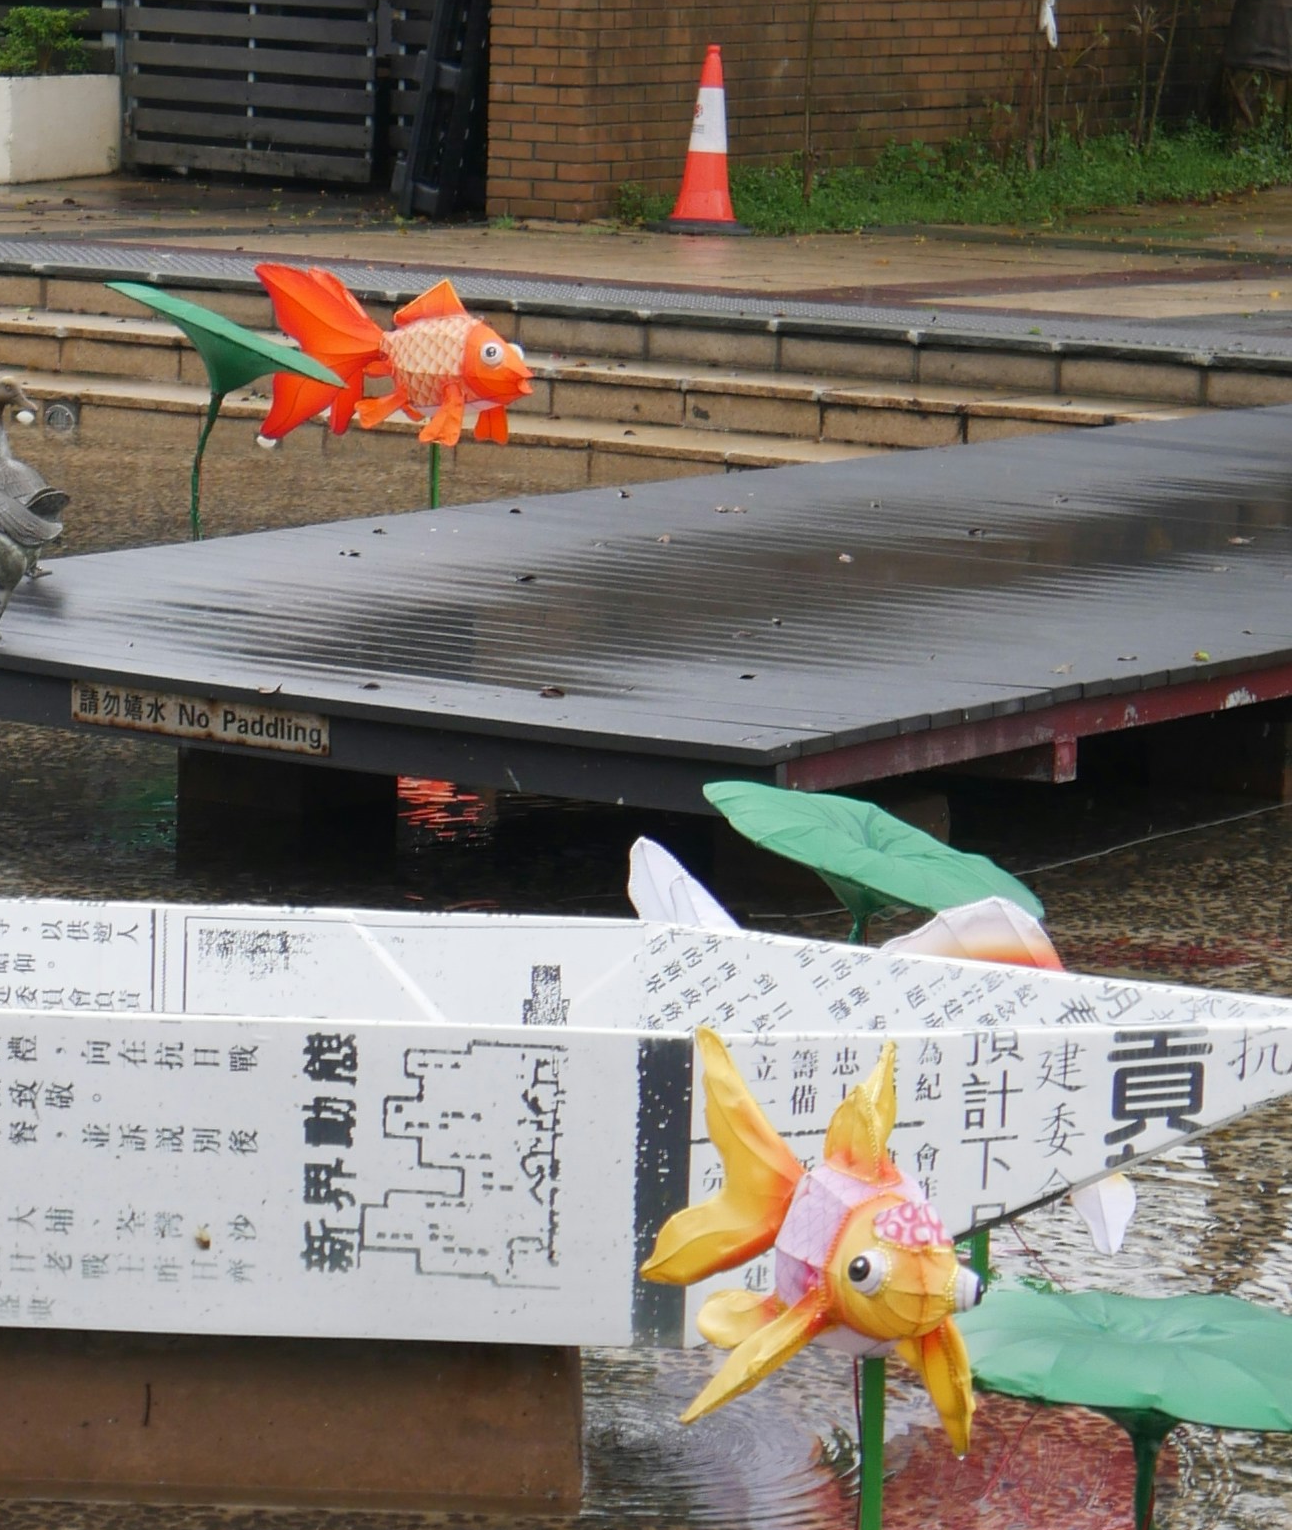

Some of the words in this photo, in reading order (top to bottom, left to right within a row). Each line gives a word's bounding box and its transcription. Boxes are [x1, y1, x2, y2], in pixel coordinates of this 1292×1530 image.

[79, 688, 166, 723] 請勿嬉水
[178, 704, 210, 730] No
[222, 709, 322, 749] Paddling
[1104, 1026, 1213, 1170] 貢
